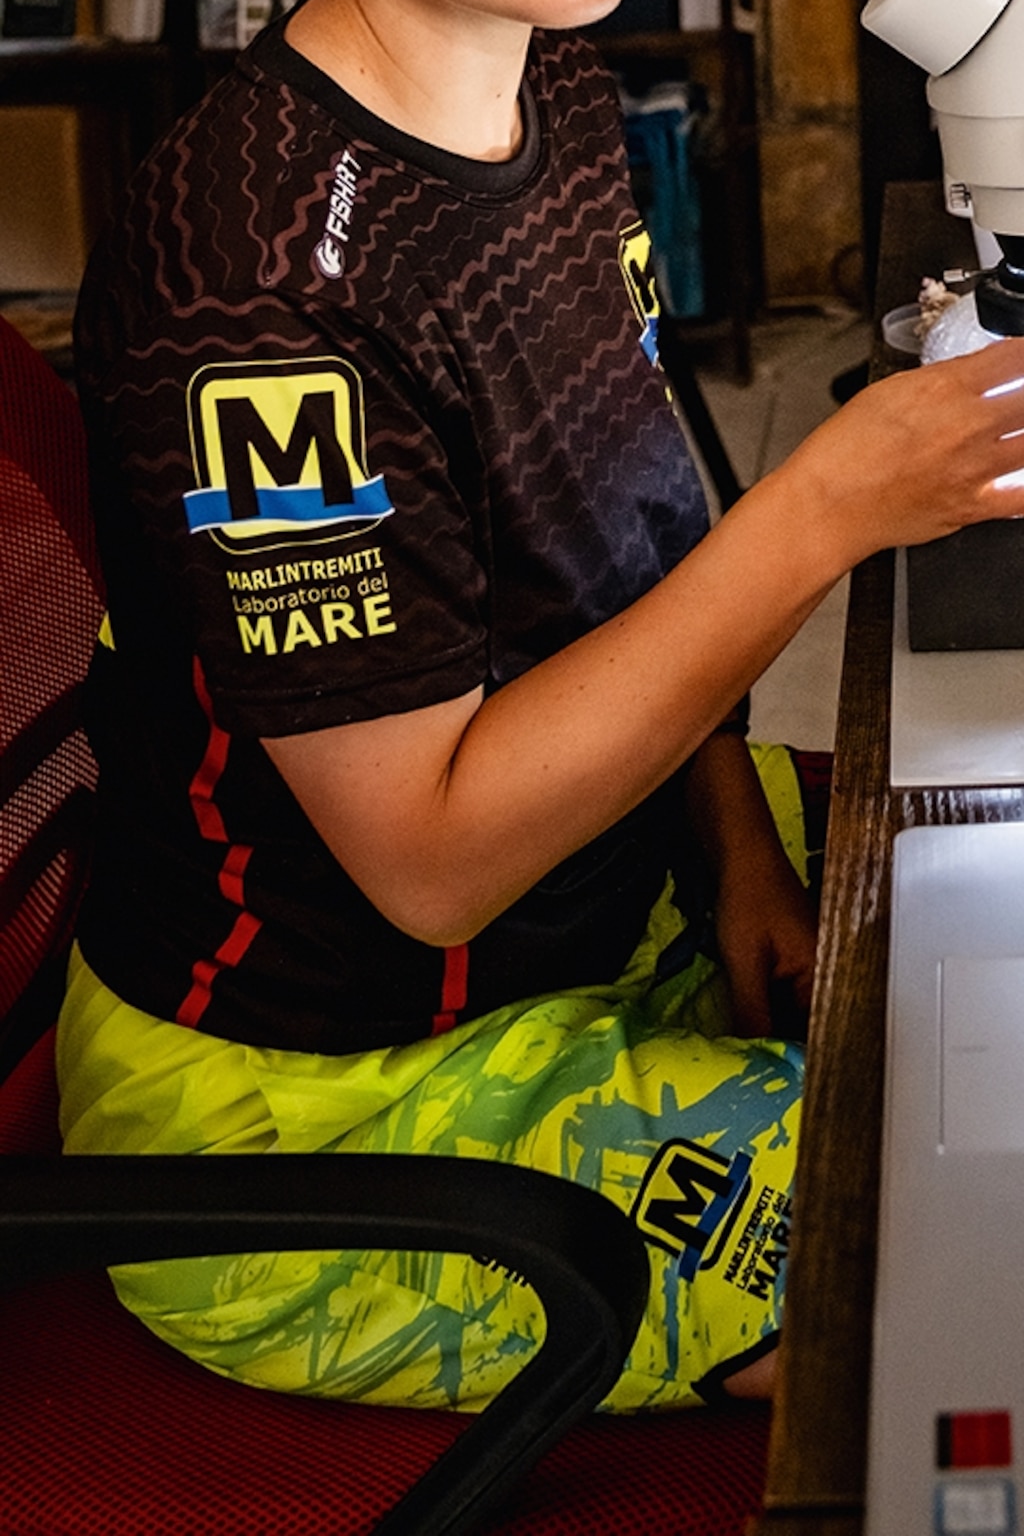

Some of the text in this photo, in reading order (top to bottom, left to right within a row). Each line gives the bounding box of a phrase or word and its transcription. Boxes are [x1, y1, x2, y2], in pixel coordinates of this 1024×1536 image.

[215, 390, 354, 521] M
[226, 546, 385, 592] MARLINTREMITI
[232, 571, 389, 614] Laboratorio del
[236, 592, 397, 656] MARE
[643, 1153, 736, 1251] M
